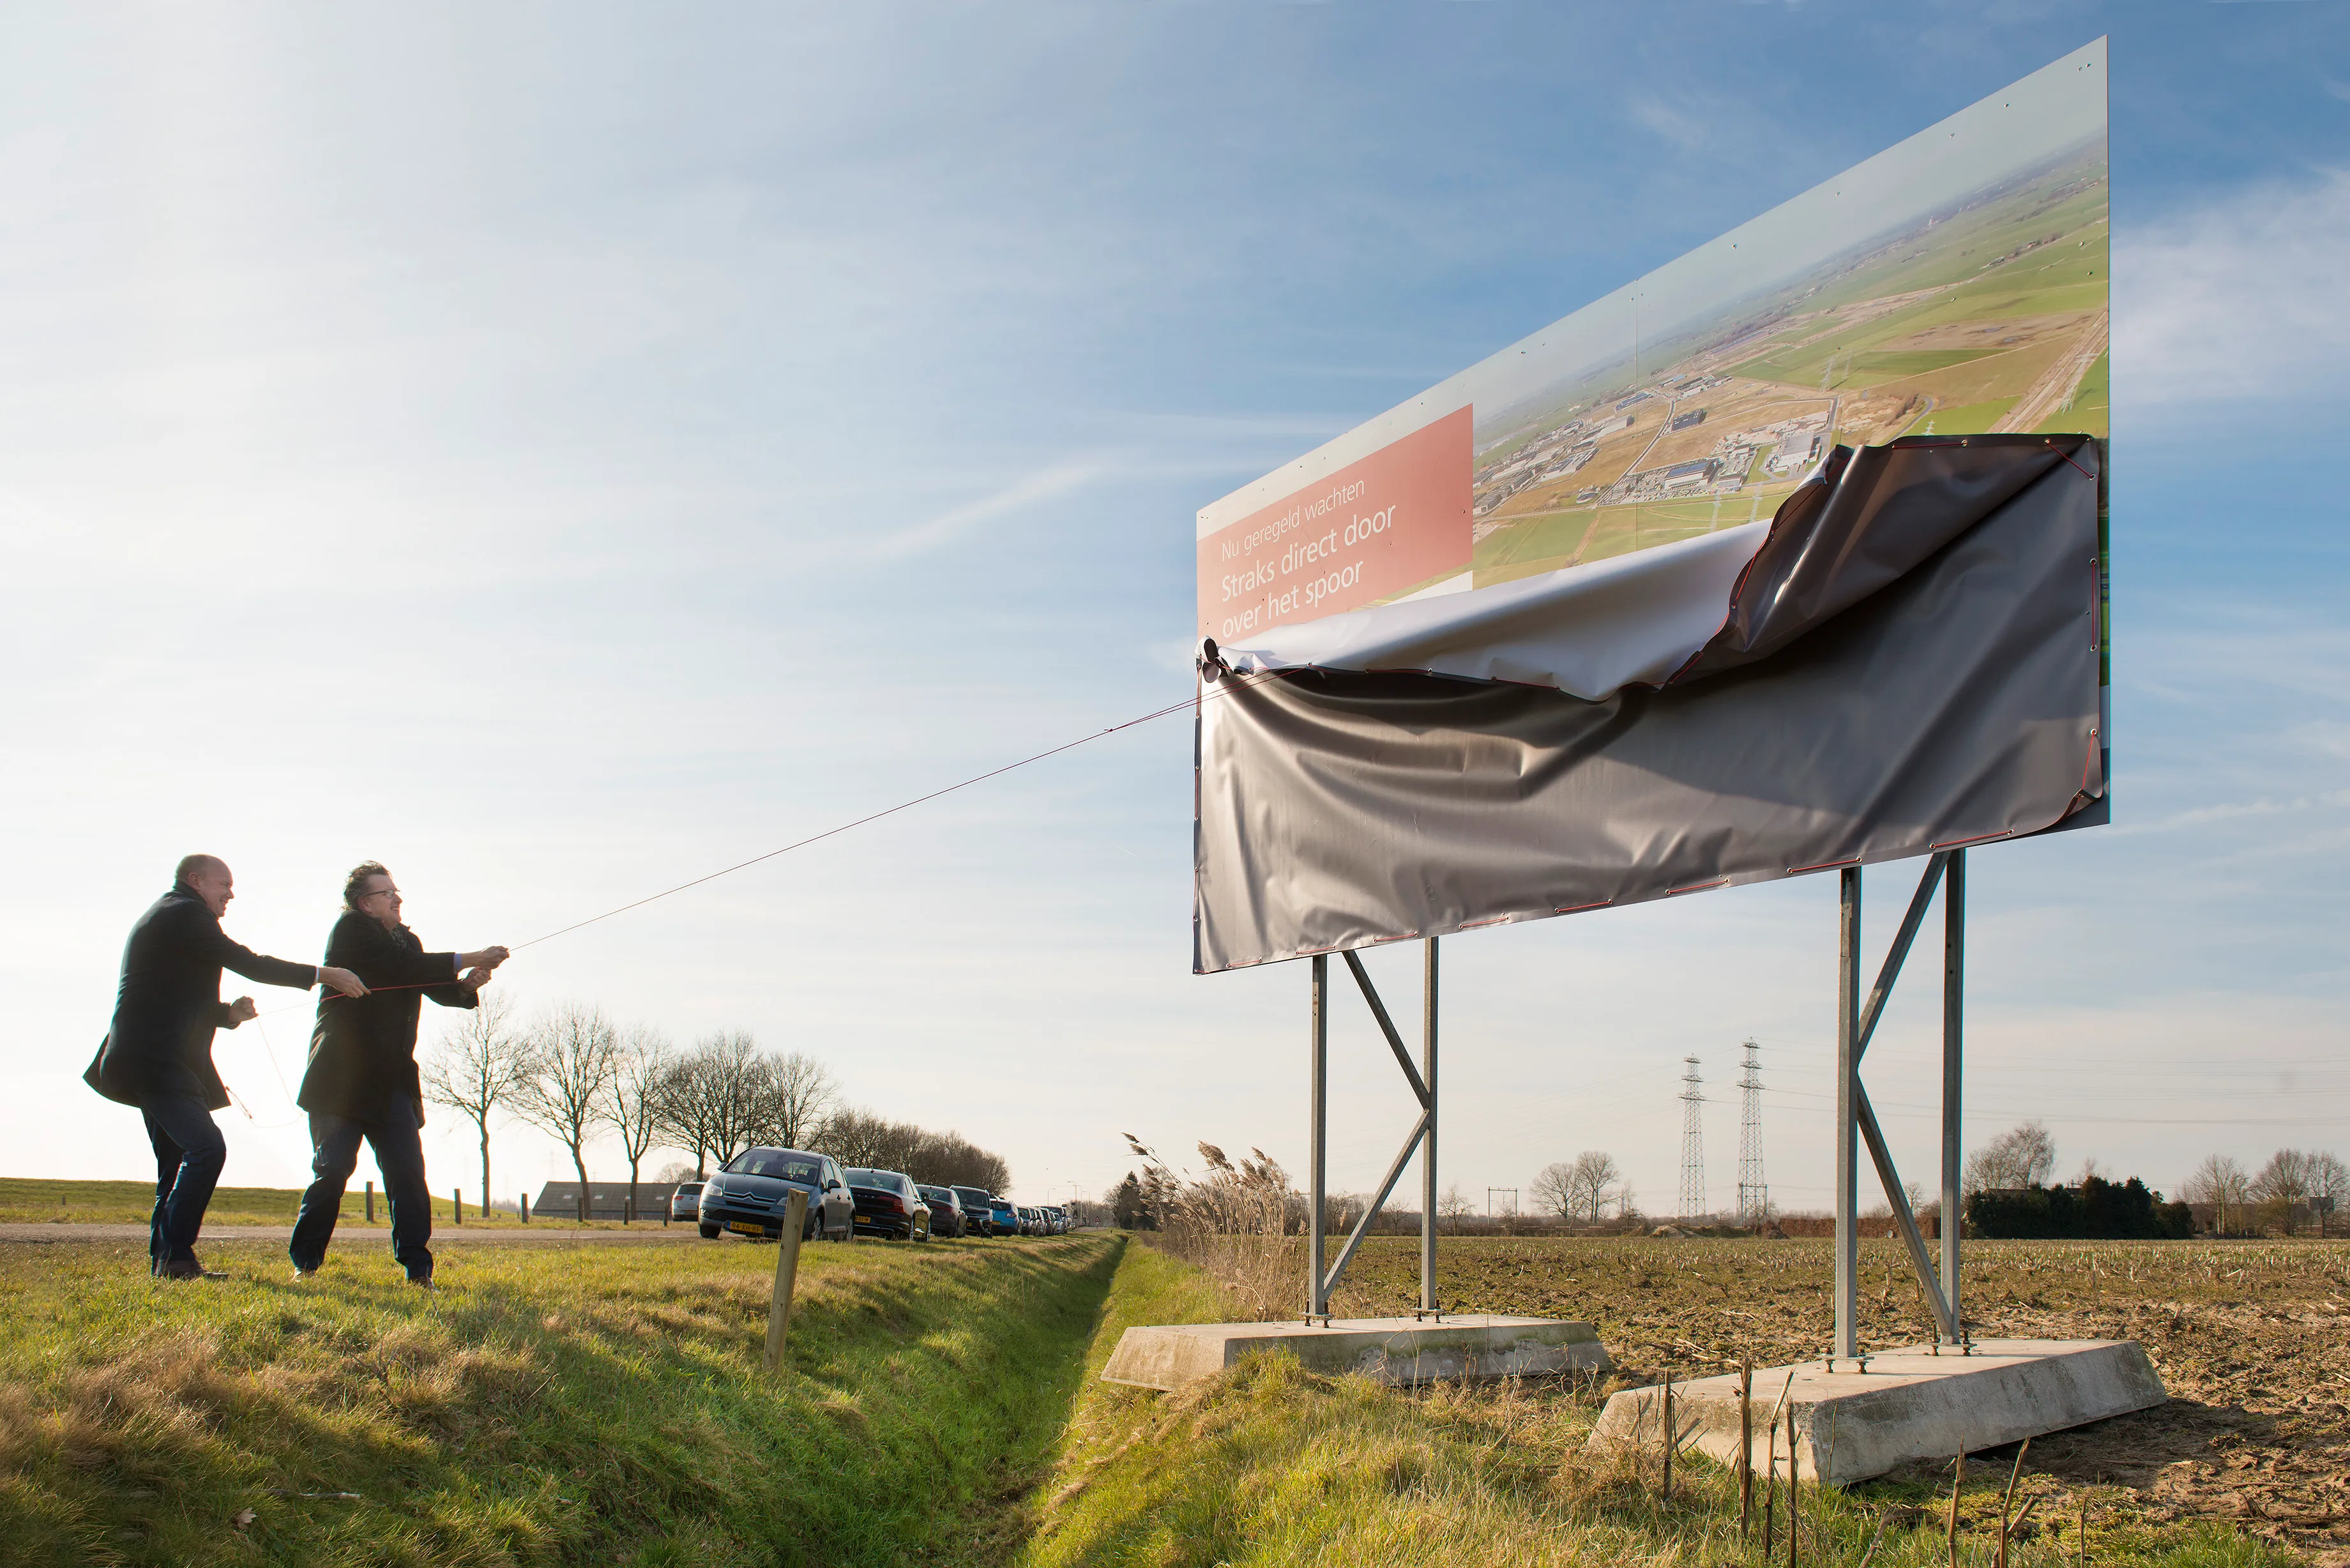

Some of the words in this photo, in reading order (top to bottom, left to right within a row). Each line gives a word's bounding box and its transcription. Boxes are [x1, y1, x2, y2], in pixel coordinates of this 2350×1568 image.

[1222, 540, 1239, 562] Nu
[1244, 505, 1300, 556] geregeld
[1305, 479, 1364, 521] wachten
[1222, 559, 1275, 602] Straks
[1281, 528, 1337, 575] direct
[1344, 504, 1396, 547] door
[1222, 604, 1262, 638] over
[1268, 585, 1299, 621] het
[1305, 561, 1363, 608] spoor
[732, 1223, 761, 1232] 94-XH-RF
